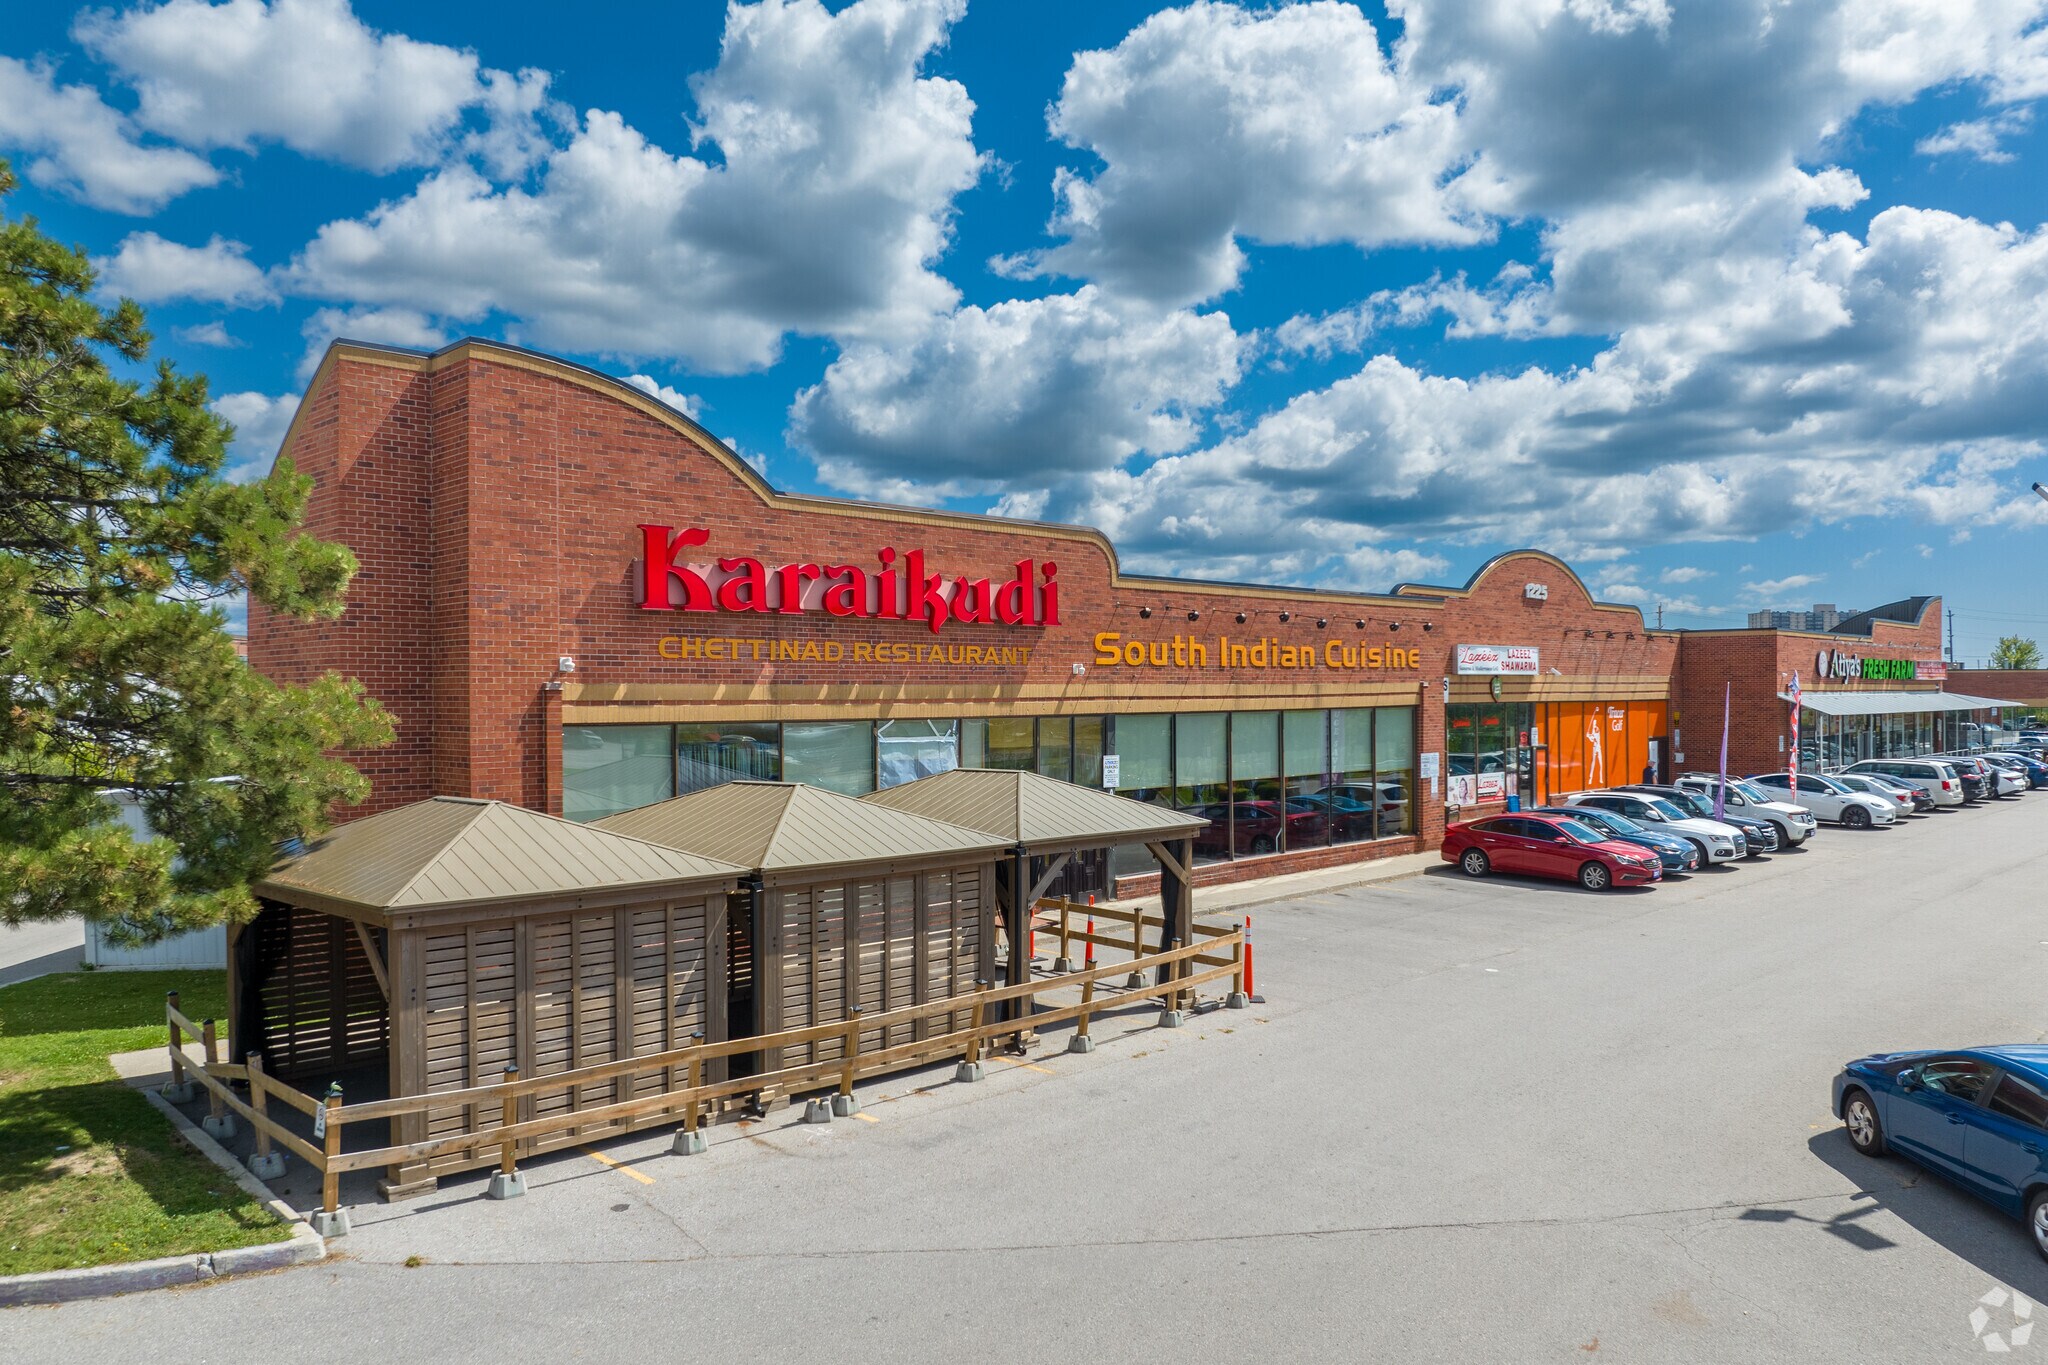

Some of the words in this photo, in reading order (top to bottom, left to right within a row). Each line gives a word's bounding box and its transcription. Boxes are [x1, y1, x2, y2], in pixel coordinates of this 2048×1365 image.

[637, 524, 1062, 635] Karaikudi
[1525, 583, 1548, 600] 1225
[658, 636, 844, 662] CHETTINAD
[854, 642, 1032, 666] RESTAURANT
[1094, 632, 1207, 667] South
[1219, 636, 1316, 668] Indian
[1325, 639, 1420, 668] Cuisine
[1507, 648, 1532, 659] LAZEEZ
[1501, 661, 1536, 671] SHAWARMA
[1830, 649, 1860, 684] Atiya's
[1862, 658, 1890, 680] FRESH
[1890, 660, 1914, 679] FARM
